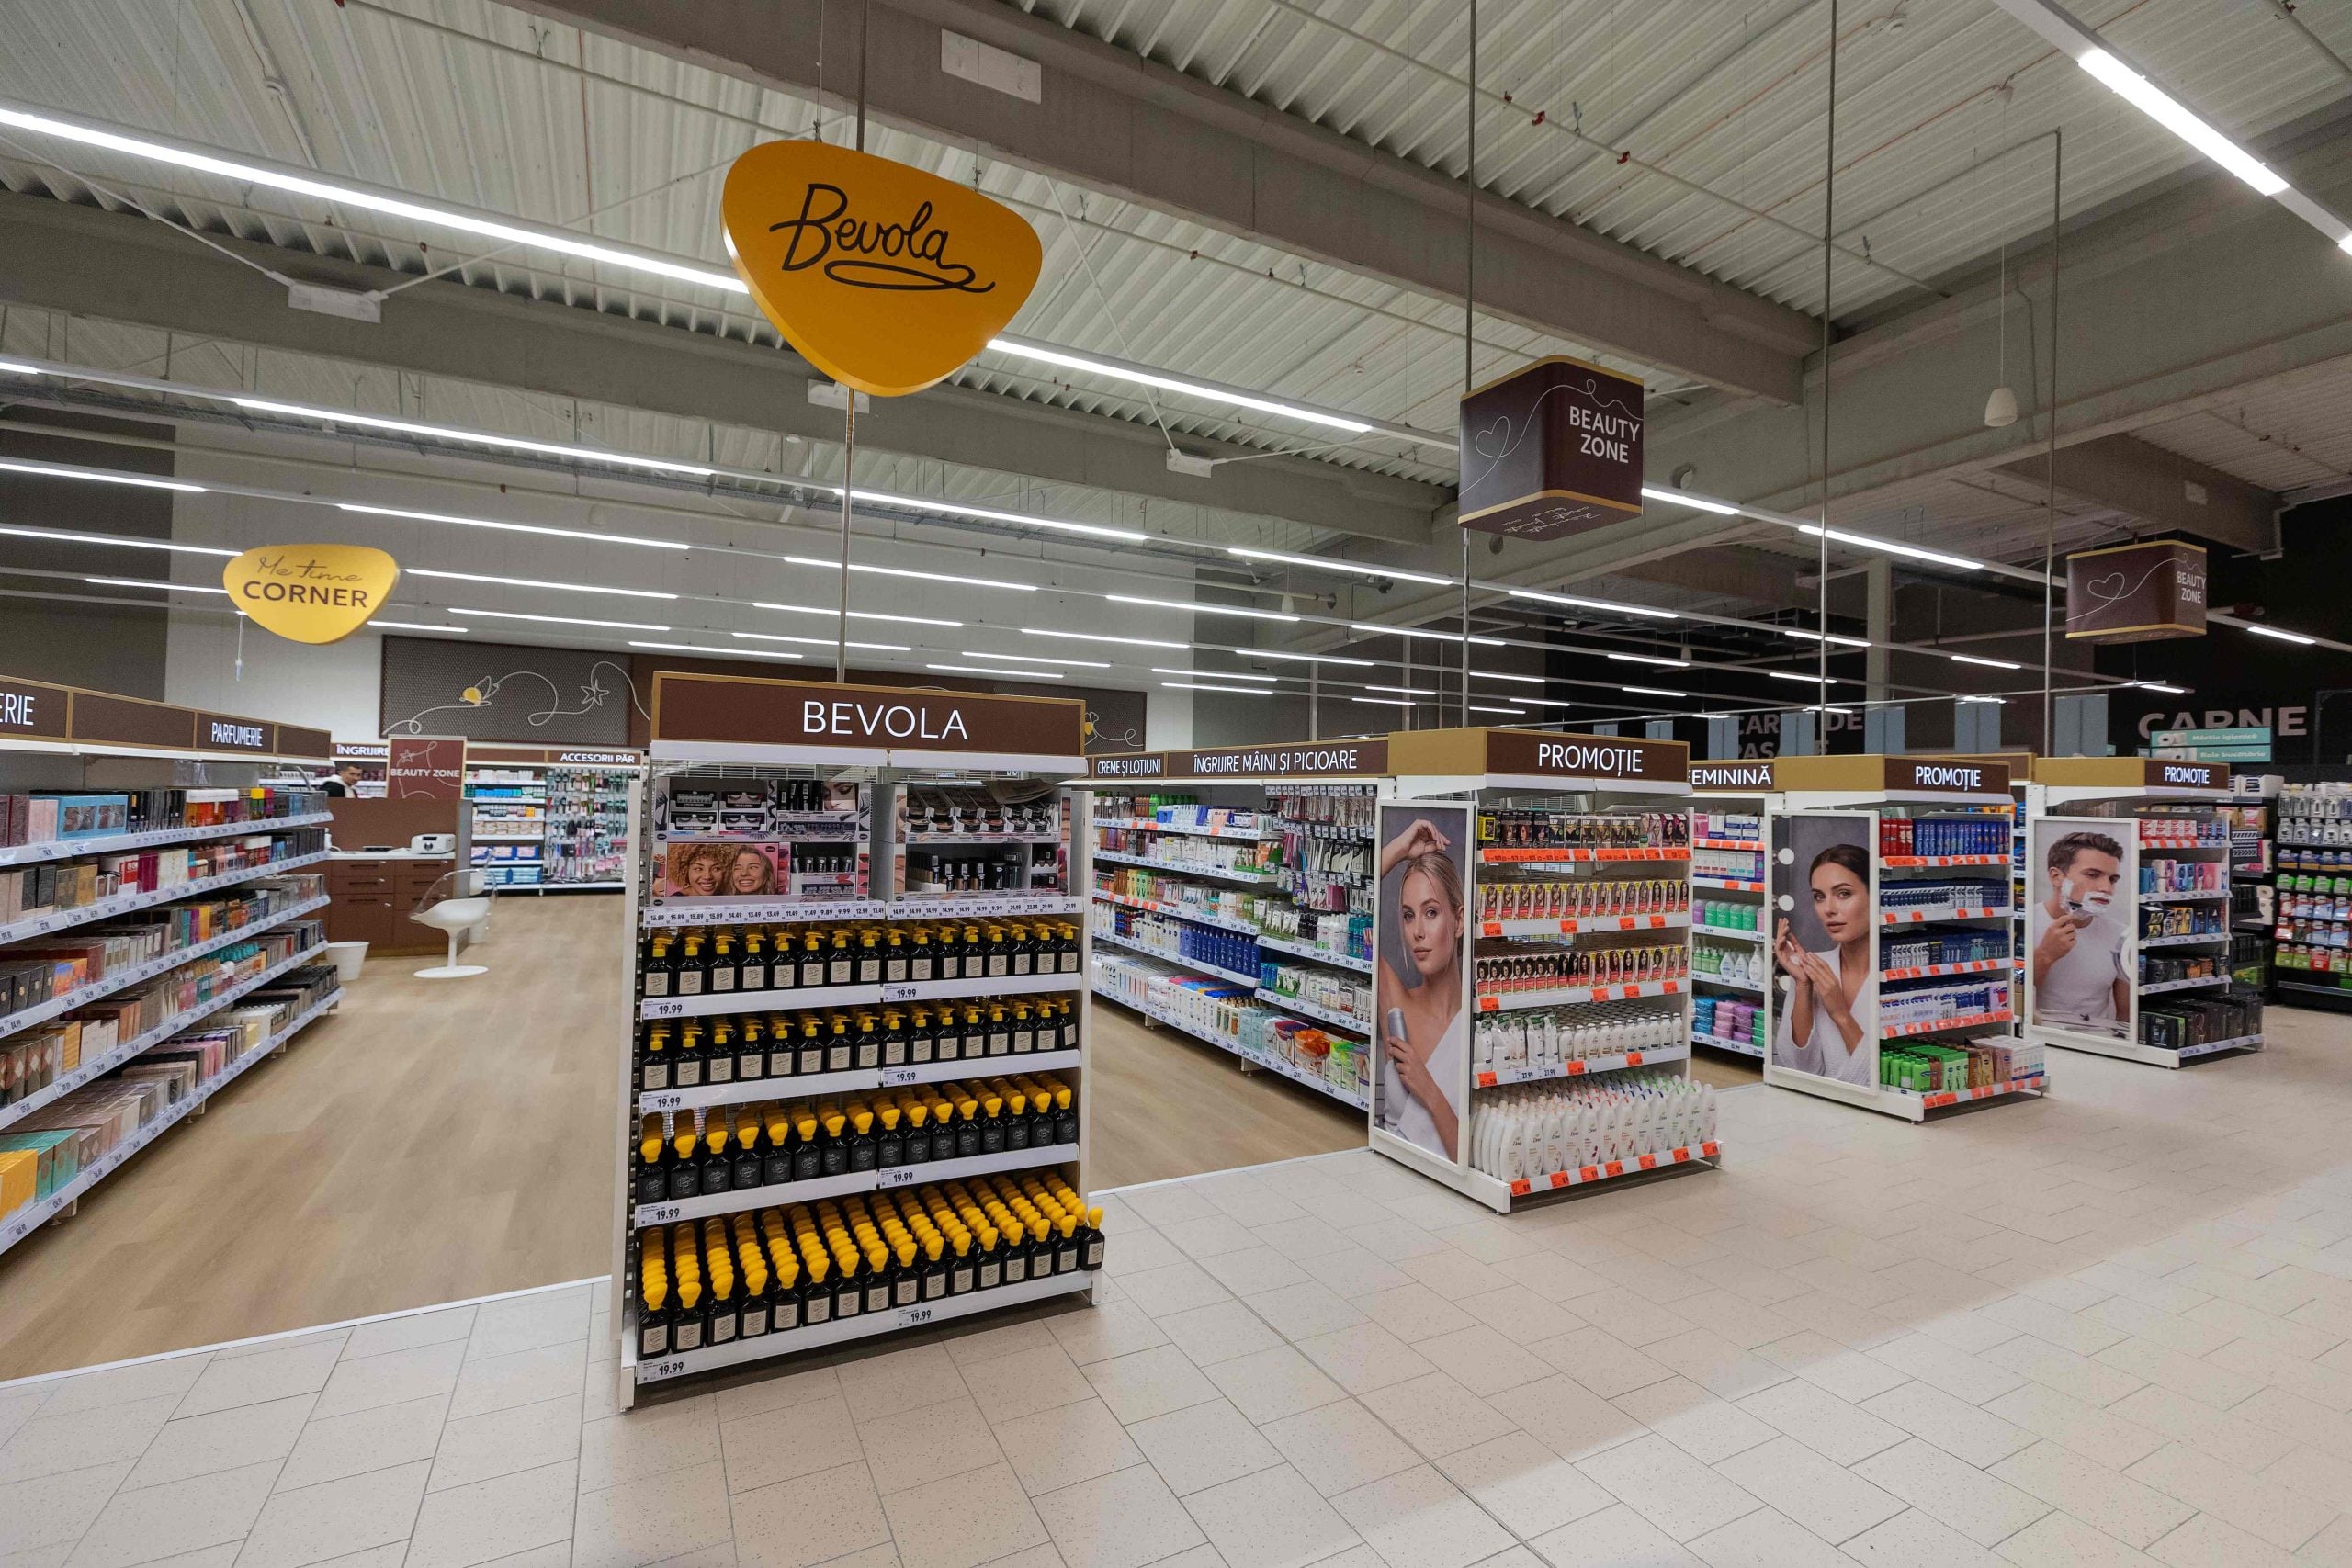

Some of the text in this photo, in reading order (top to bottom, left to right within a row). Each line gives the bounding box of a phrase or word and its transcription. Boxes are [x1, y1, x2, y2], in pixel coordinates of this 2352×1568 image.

[769, 183, 996, 293] Bevola
[1569, 405, 1640, 441] BEAUTY
[1580, 434, 1629, 463] ZONE
[257, 555, 362, 582] Me time
[2177, 570, 2207, 590] BEAUTY
[243, 581, 368, 608] CORNER
[2181, 588, 2202, 604] ZONE
[803, 700, 968, 740] BEVOLA
[211, 721, 264, 747] PARFUMERIE
[560, 753, 636, 763] ACCESORII PĂR
[1097, 758, 1161, 777] CREME ȘI LOȚIUNI
[1193, 750, 1357, 775] ÎNGRIJIRE MÂINI ȘI PICIOARE
[1538, 742, 1643, 776] PROMOȚIE
[390, 768, 459, 777] BEAUTY ZONE
[1689, 765, 1772, 785] EMININĂ
[1915, 765, 1982, 791] PROMOȚIE
[2165, 766, 2210, 786] PROMOȚIE
[897, 988, 916, 998] 19.99
[659, 1004, 683, 1015] 19.99
[897, 1072, 916, 1082] 19.99
[657, 1097, 681, 1108] 19.99
[893, 1172, 913, 1183] 19.99
[656, 1207, 680, 1221] 19.99
[910, 1310, 932, 1322] 19.99
[659, 1362, 684, 1376] 19.99
